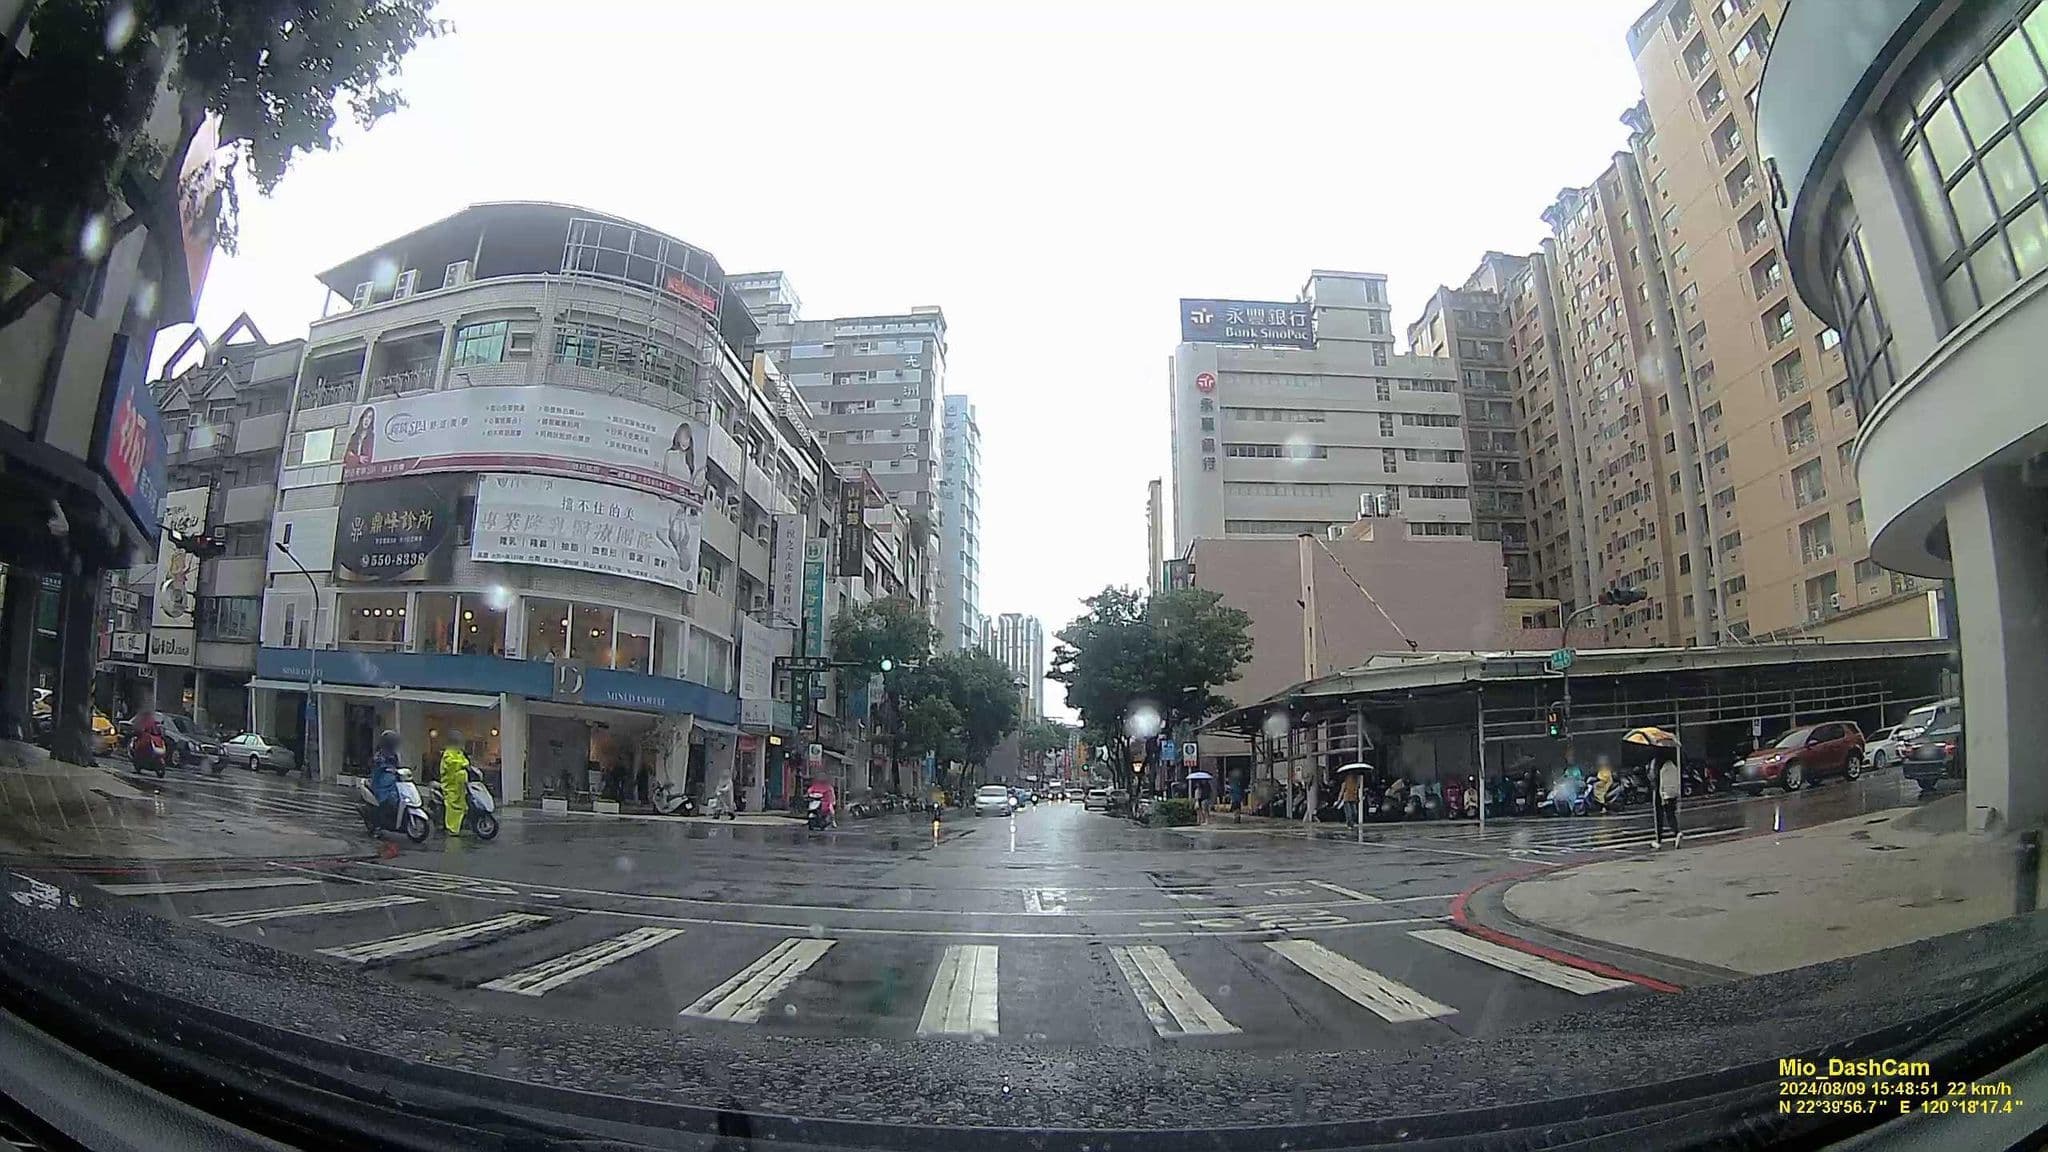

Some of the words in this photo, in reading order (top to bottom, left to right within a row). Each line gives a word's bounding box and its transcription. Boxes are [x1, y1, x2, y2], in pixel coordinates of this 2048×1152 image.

[1226, 307, 1307, 327] 永豐銀行
[1226, 327, 1258, 338] Bank
[1260, 328, 1309, 340] SinoPac
[369, 509, 434, 534] 鼎峰診所
[370, 552, 426, 567] 550-8338
